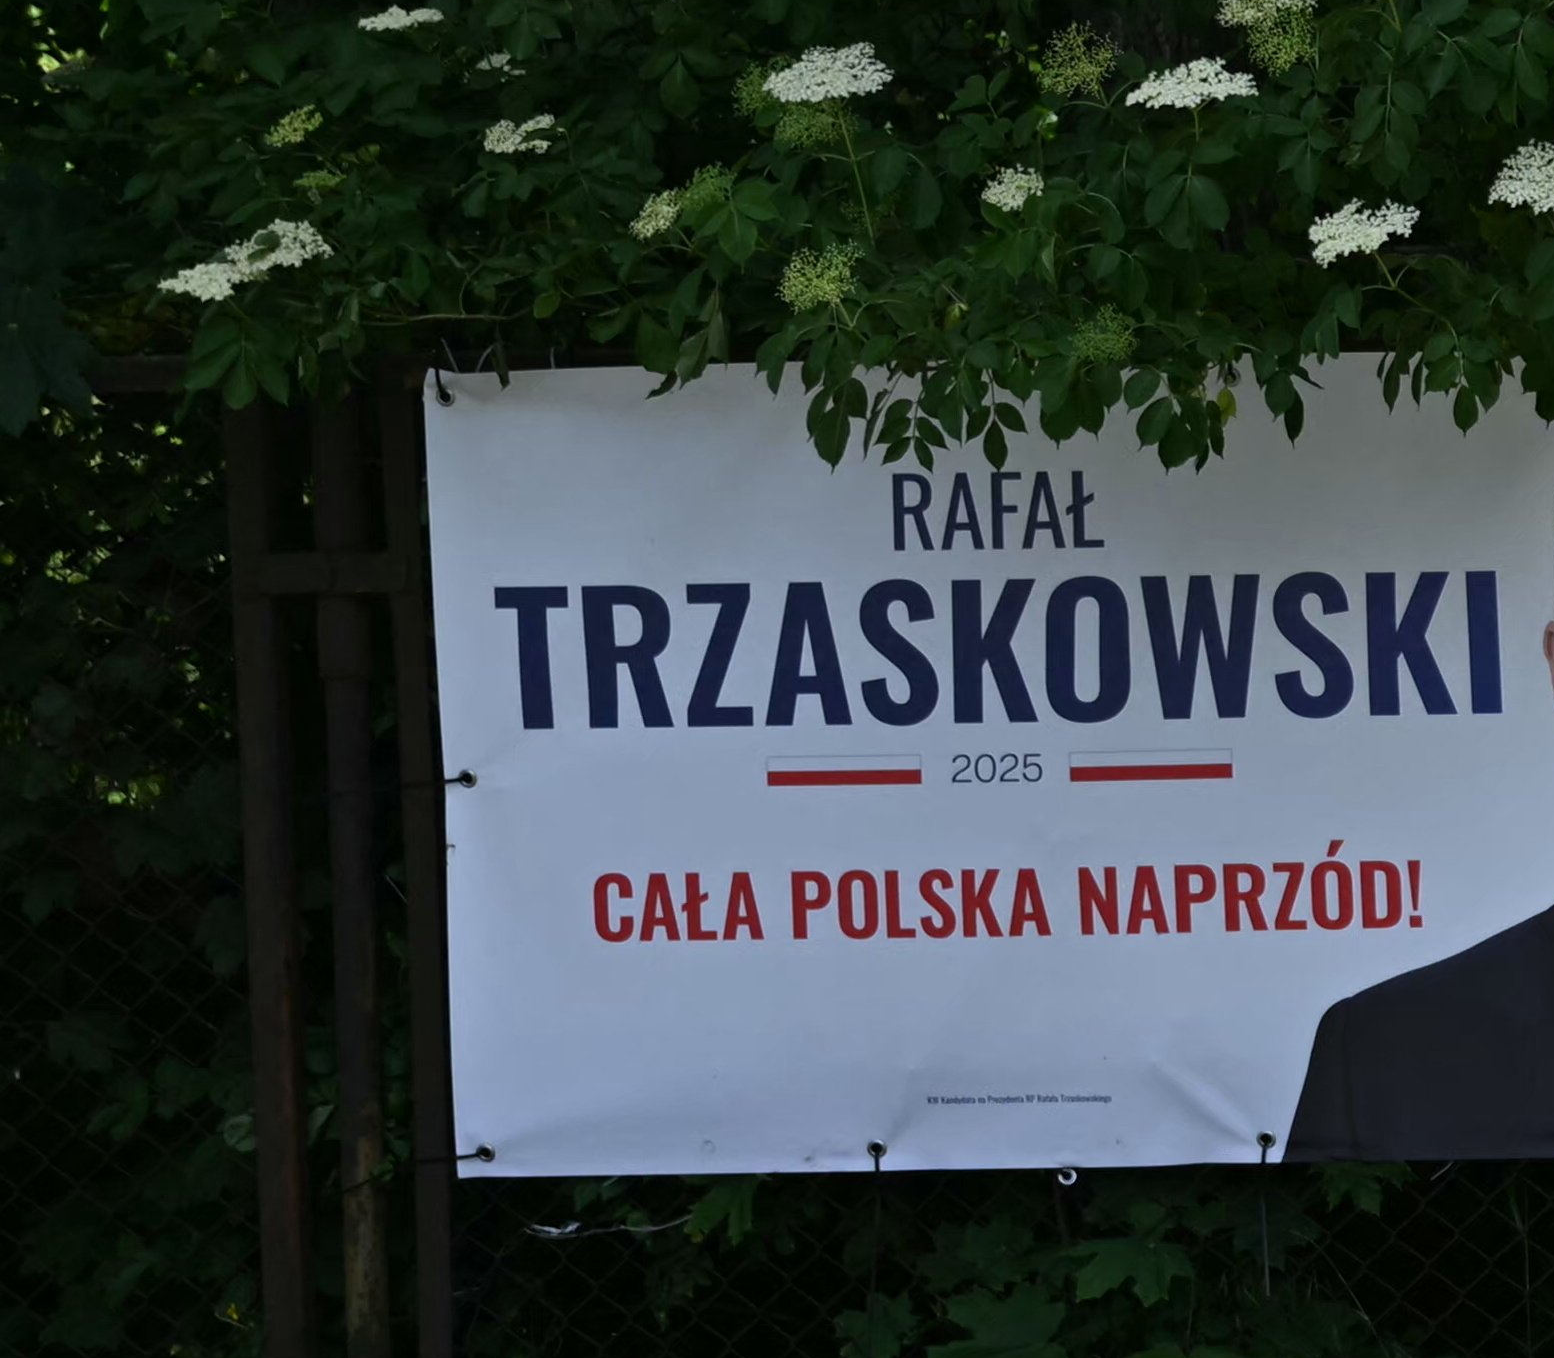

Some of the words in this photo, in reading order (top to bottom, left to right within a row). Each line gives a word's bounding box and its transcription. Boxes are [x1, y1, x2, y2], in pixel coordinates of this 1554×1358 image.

[891, 469, 1105, 551] RAFAŁ
[493, 570, 1503, 730] TRZASKOWSKI
[951, 752, 1043, 784] 2025
[593, 871, 765, 943] CAŁA
[790, 868, 1052, 940] POLSKA
[1077, 839, 1423, 936] NAPRZÓD!
